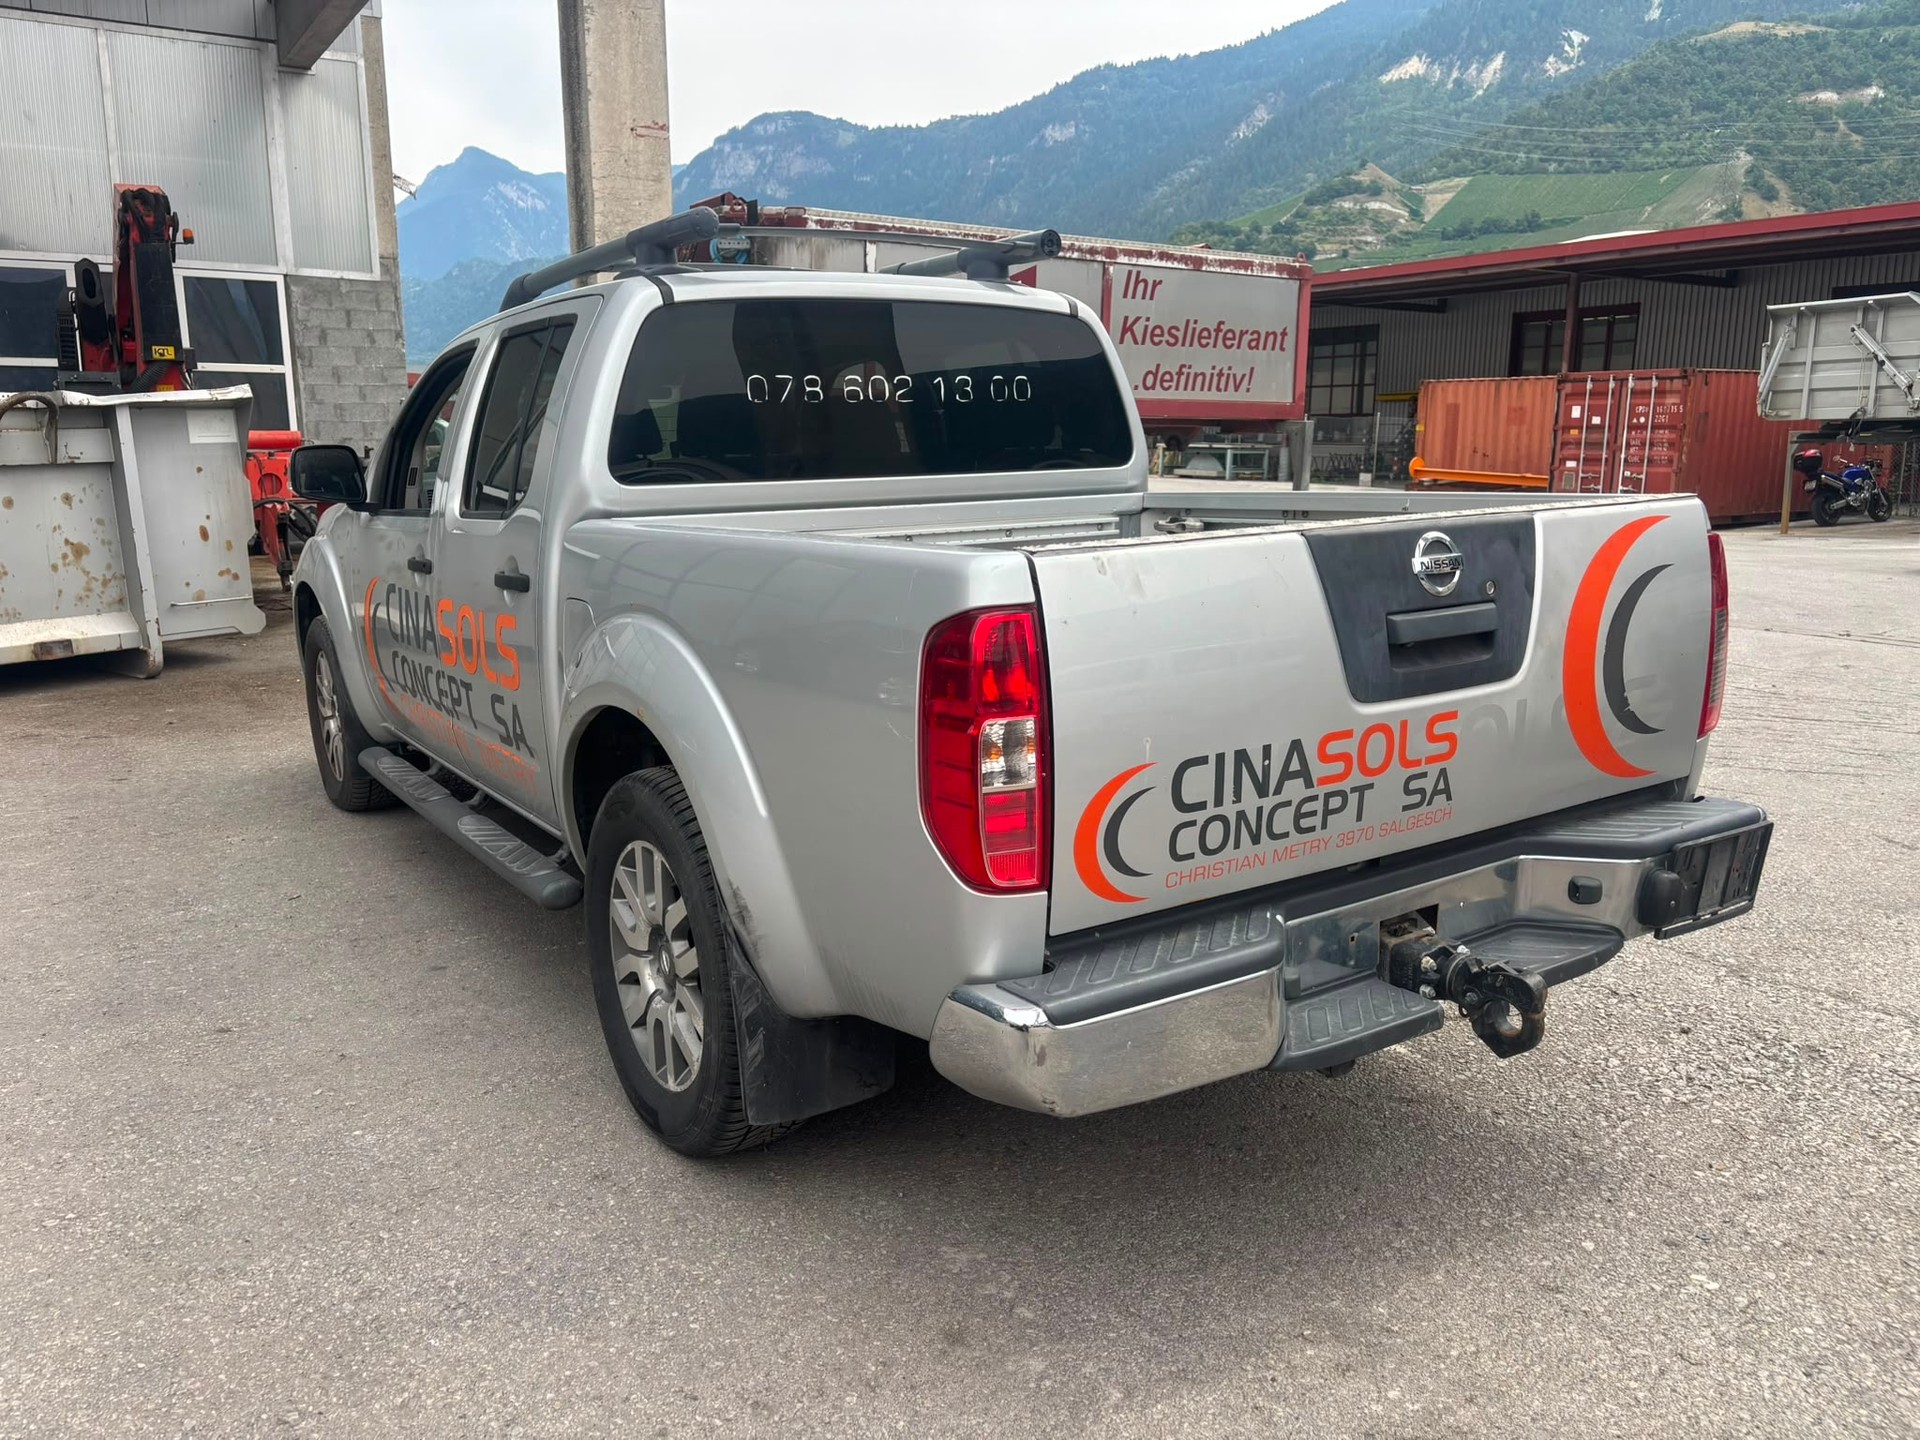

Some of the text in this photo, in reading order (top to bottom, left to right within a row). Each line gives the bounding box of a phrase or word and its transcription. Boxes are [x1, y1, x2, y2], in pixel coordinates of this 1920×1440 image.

[1122, 269, 1163, 301] Ihr
[1118, 315, 1288, 352] Kieslieferant
[746, 374, 1031, 403] 078 602 13 00
[1420, 558, 1464, 570] NISSAN
[385, 582, 521, 692] CINASOLS
[391, 650, 478, 730] CONCEPT
[490, 693, 535, 759] SA
[1170, 710, 1459, 815] CINASOLS
[1165, 806, 1453, 889] CHRISTIAN METRY 3970 SALGESCH
[1168, 767, 1453, 863] CONCEPT SA
